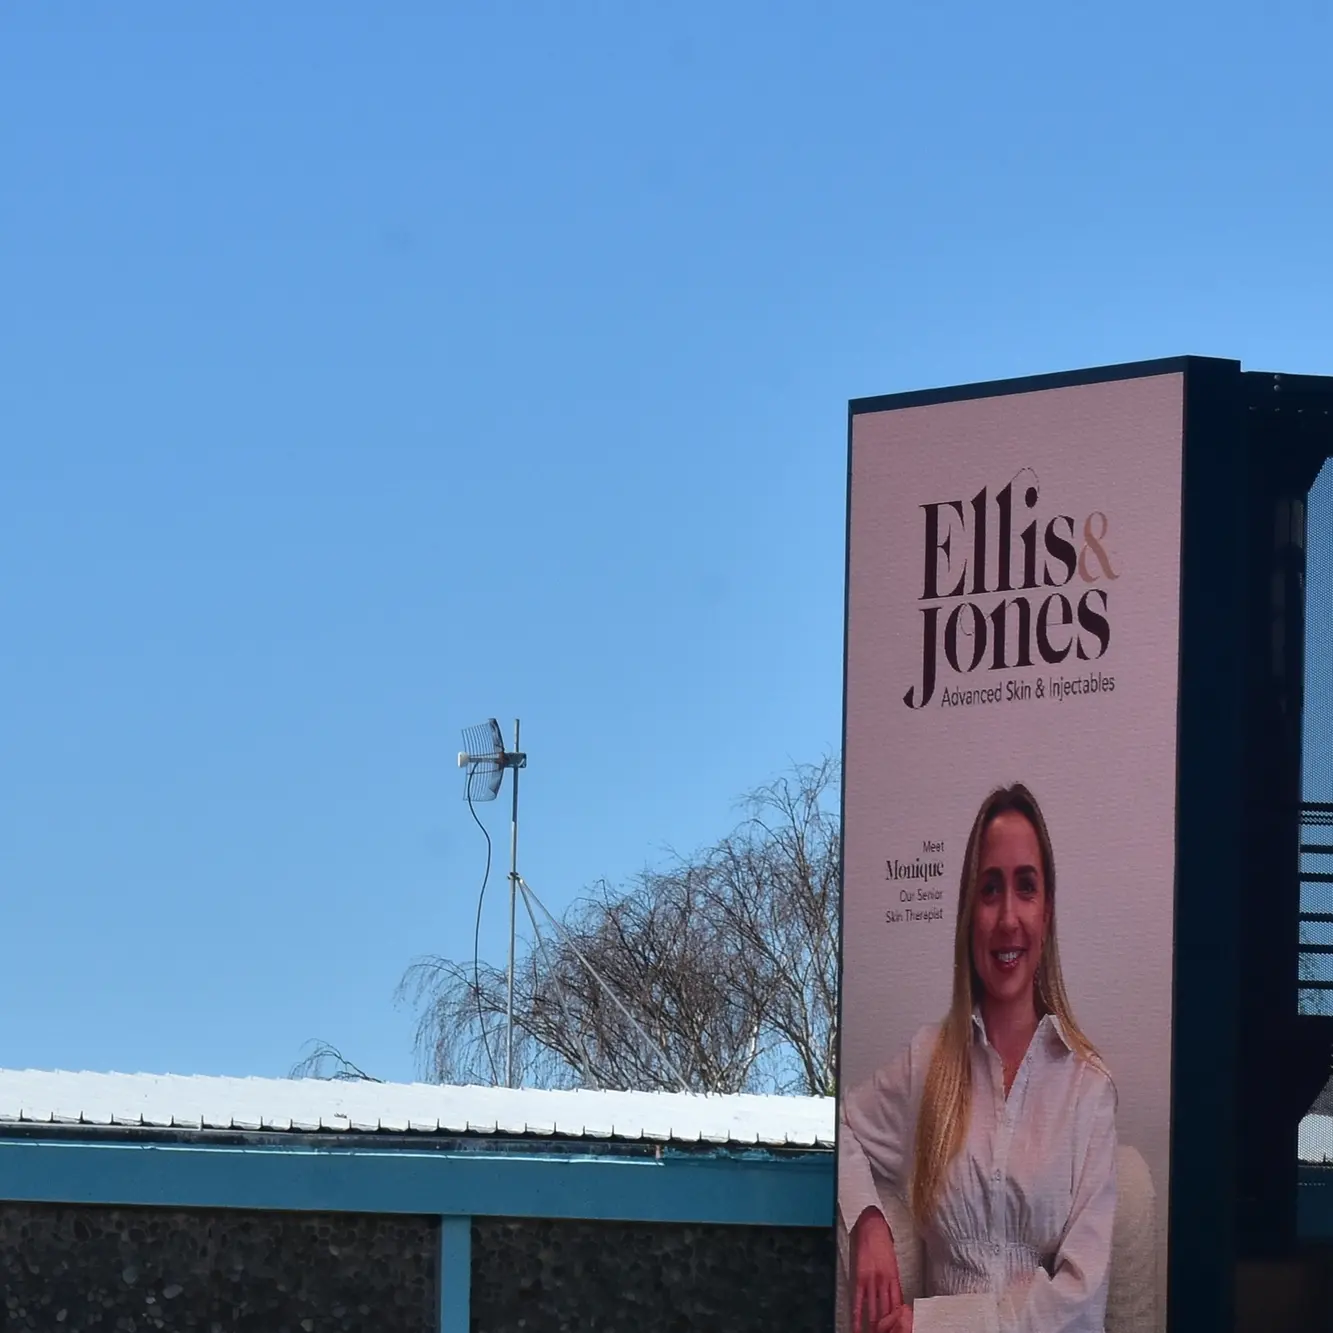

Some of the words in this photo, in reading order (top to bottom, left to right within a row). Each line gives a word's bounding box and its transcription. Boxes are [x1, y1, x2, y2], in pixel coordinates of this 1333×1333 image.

[902, 589, 1111, 710] Jones
[941, 681, 1002, 707] Advanced
[1006, 680, 1031, 701] Skin
[1034, 677, 1046, 699] &
[1050, 672, 1115, 701] Injectables
[922, 840, 945, 853] Meet
[884, 857, 944, 882] Monique
[900, 889, 914, 902] Our
[917, 887, 943, 901] Senior
[885, 909, 903, 923] Skin
[905, 906, 943, 923] Therapist
